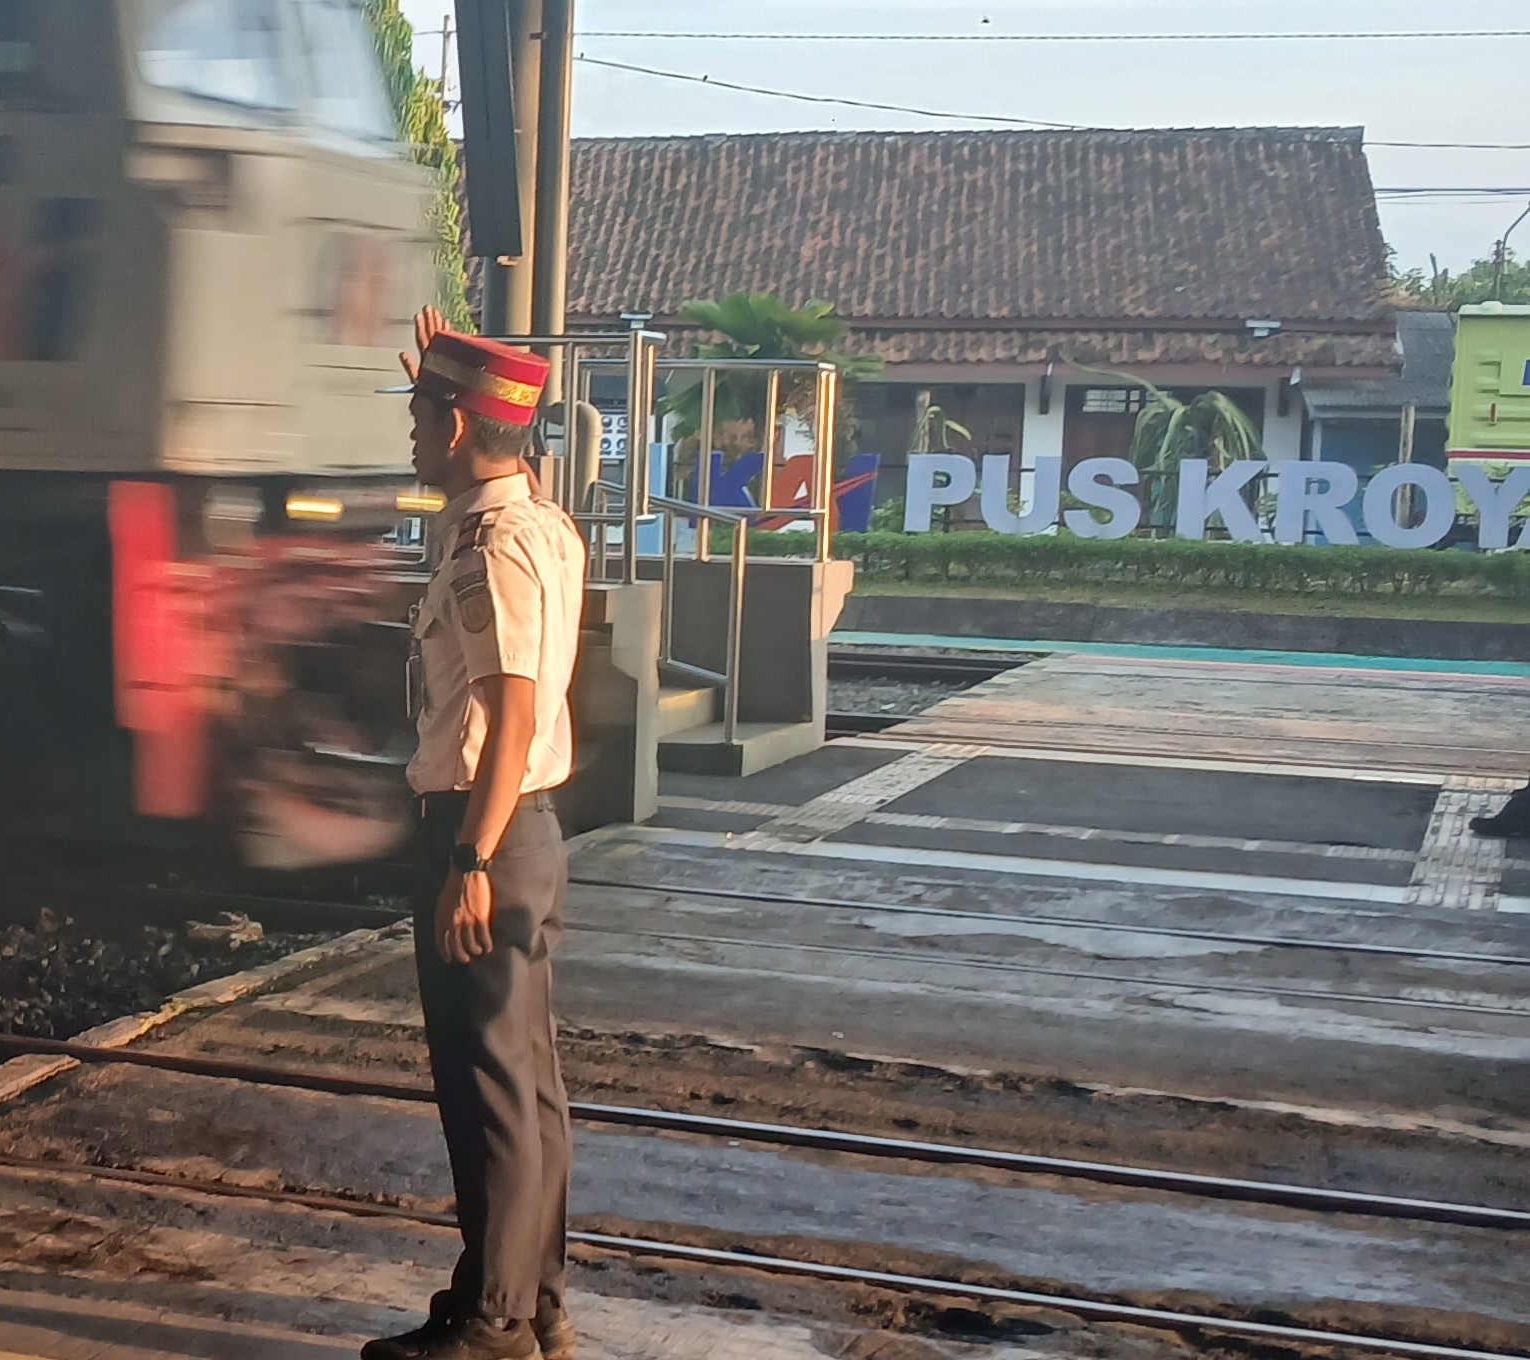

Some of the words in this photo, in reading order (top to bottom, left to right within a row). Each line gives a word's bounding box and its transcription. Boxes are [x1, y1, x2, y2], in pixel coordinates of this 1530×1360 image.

[689, 451, 882, 532] KAI
[904, 453, 1141, 540] PUS
[1176, 458, 1530, 551] KROY
